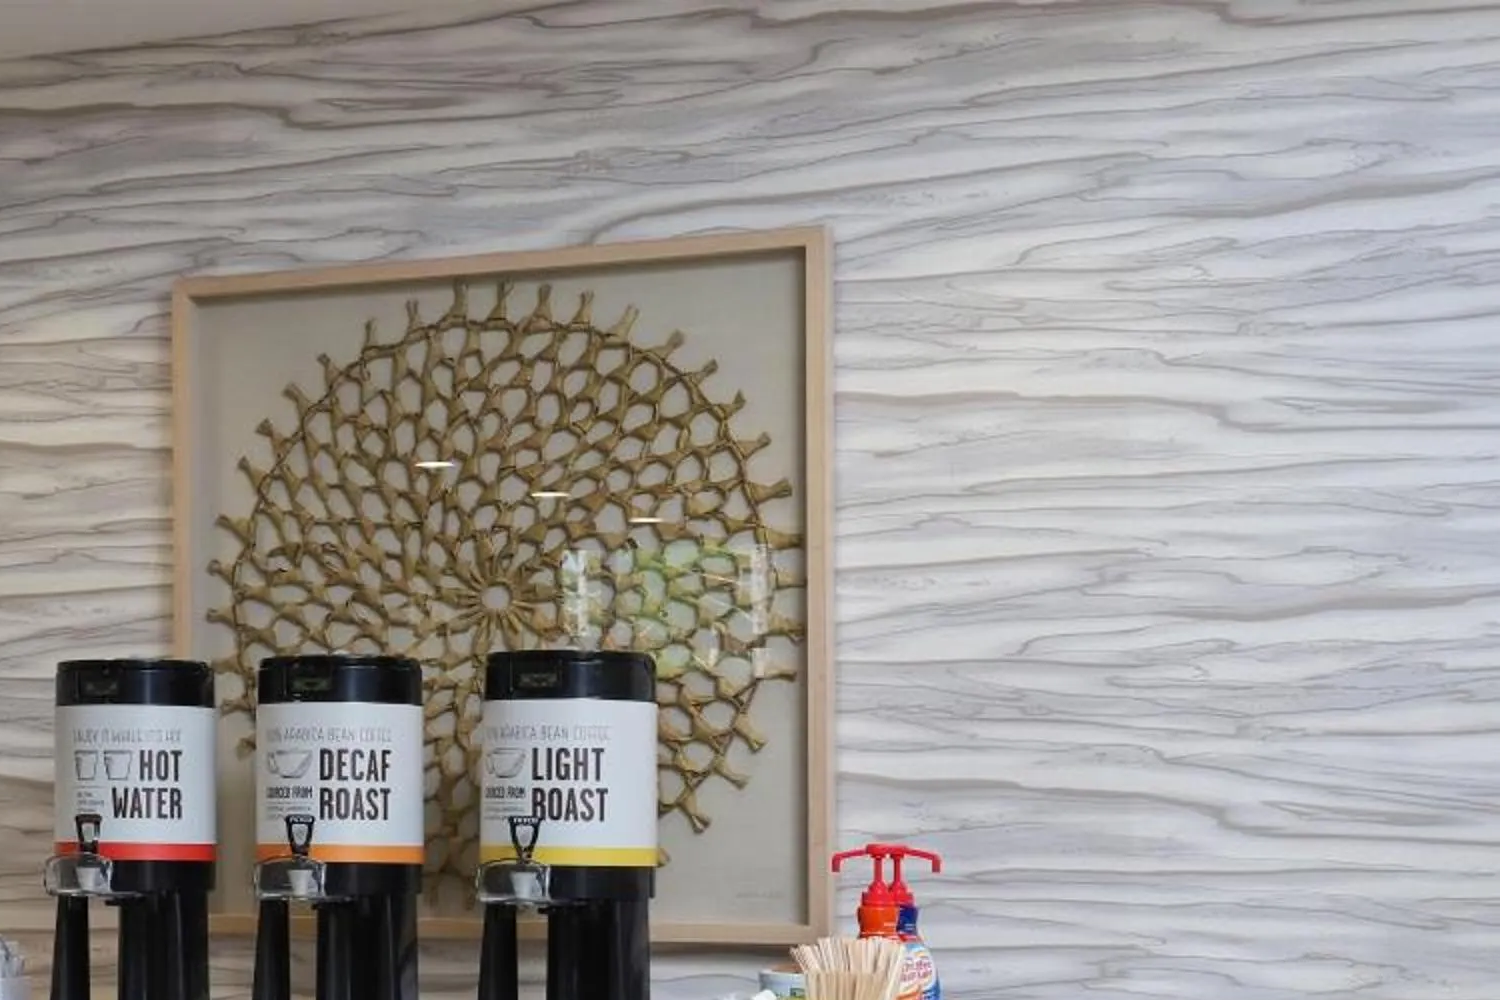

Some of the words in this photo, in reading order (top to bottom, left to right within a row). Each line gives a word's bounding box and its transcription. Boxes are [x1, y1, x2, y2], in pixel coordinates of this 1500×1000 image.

[139, 749, 183, 782] HOT
[319, 748, 392, 782] DECAF
[532, 747, 605, 782] LIGHT
[112, 786, 183, 820] WATER
[319, 787, 391, 821] ROAST
[532, 787, 609, 823] ROAST
